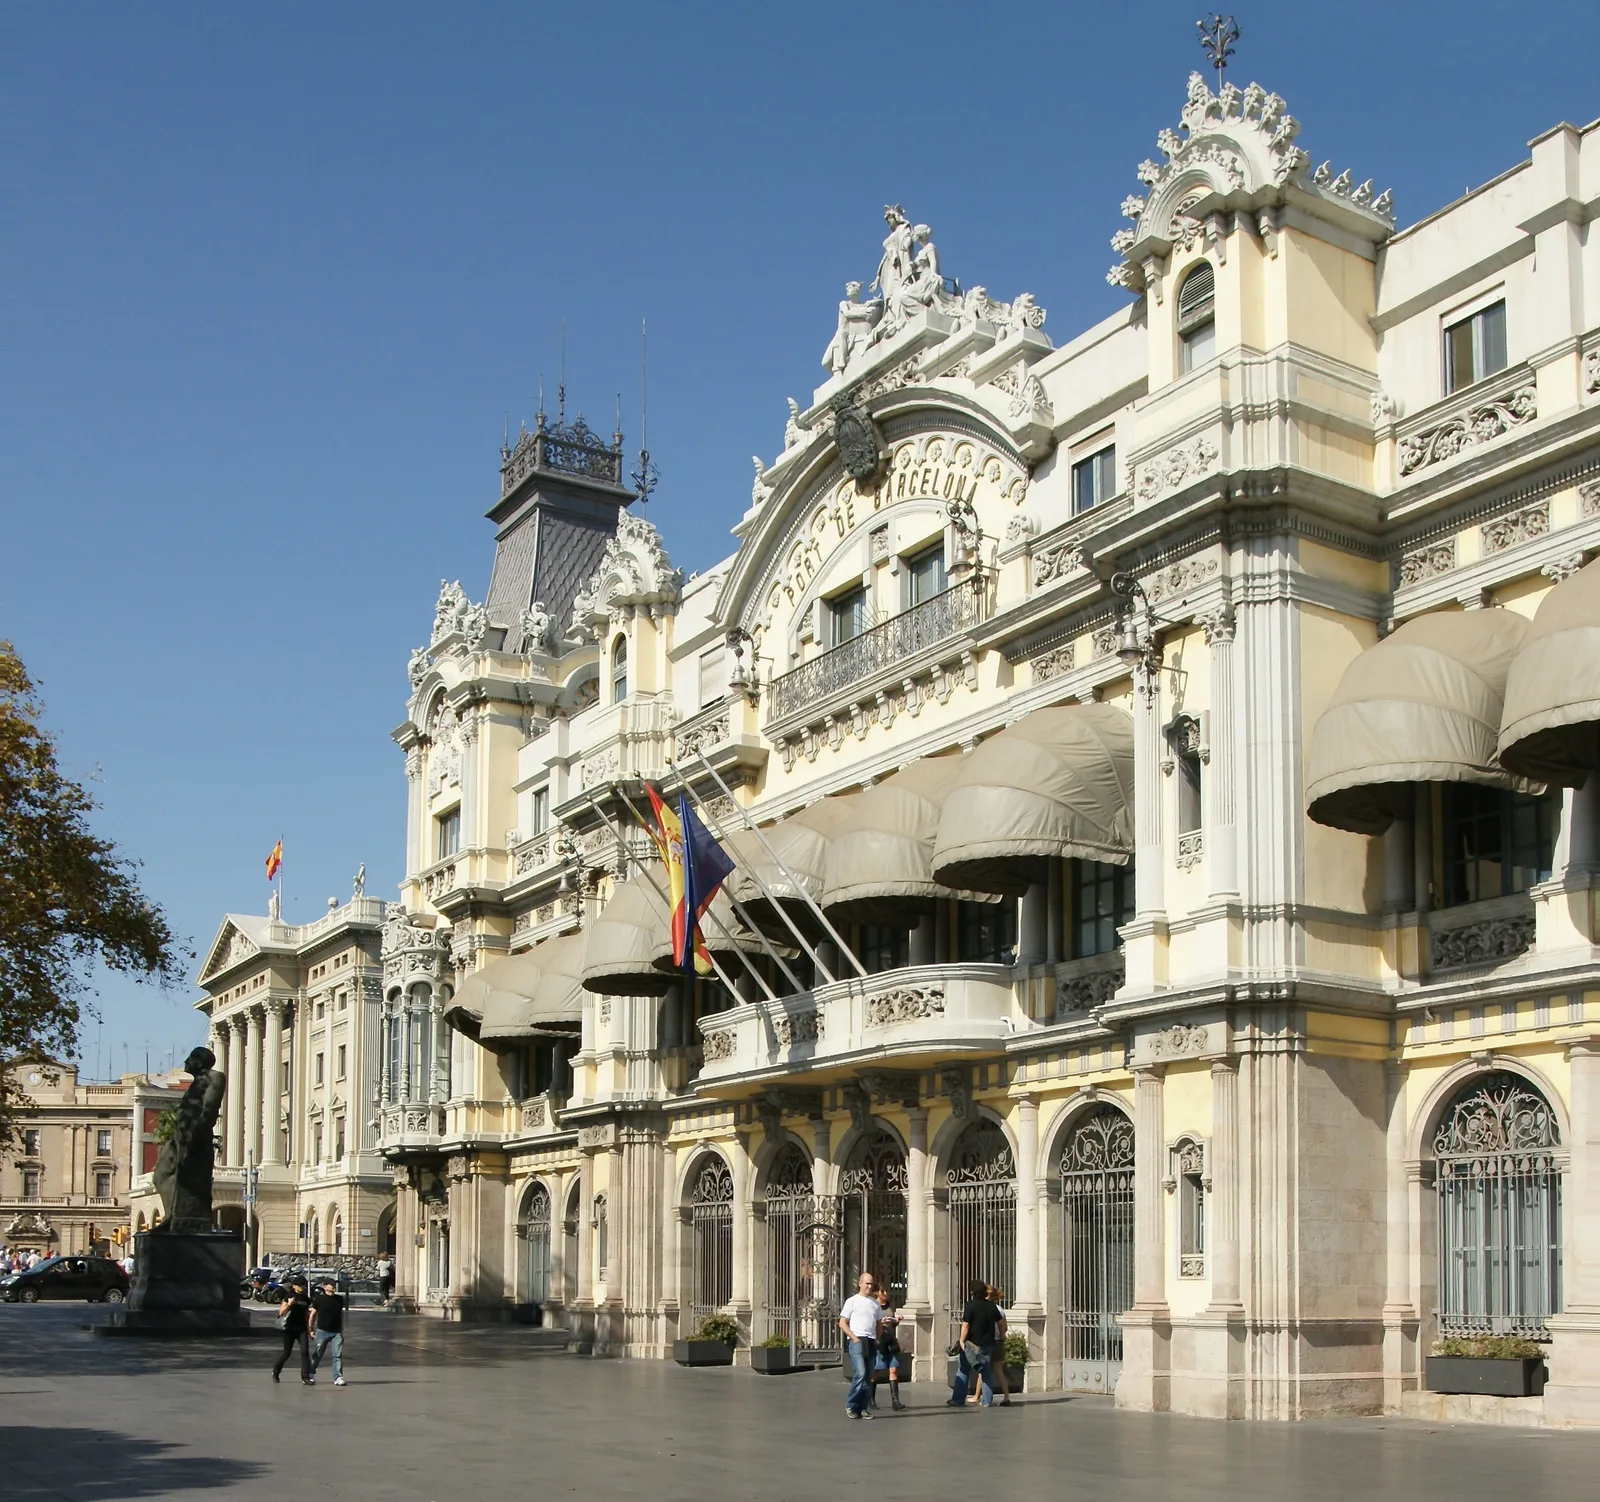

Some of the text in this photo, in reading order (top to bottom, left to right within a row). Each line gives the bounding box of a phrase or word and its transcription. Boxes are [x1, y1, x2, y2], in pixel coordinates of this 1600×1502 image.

[786, 467, 978, 607] PORT DE BARCELONA
